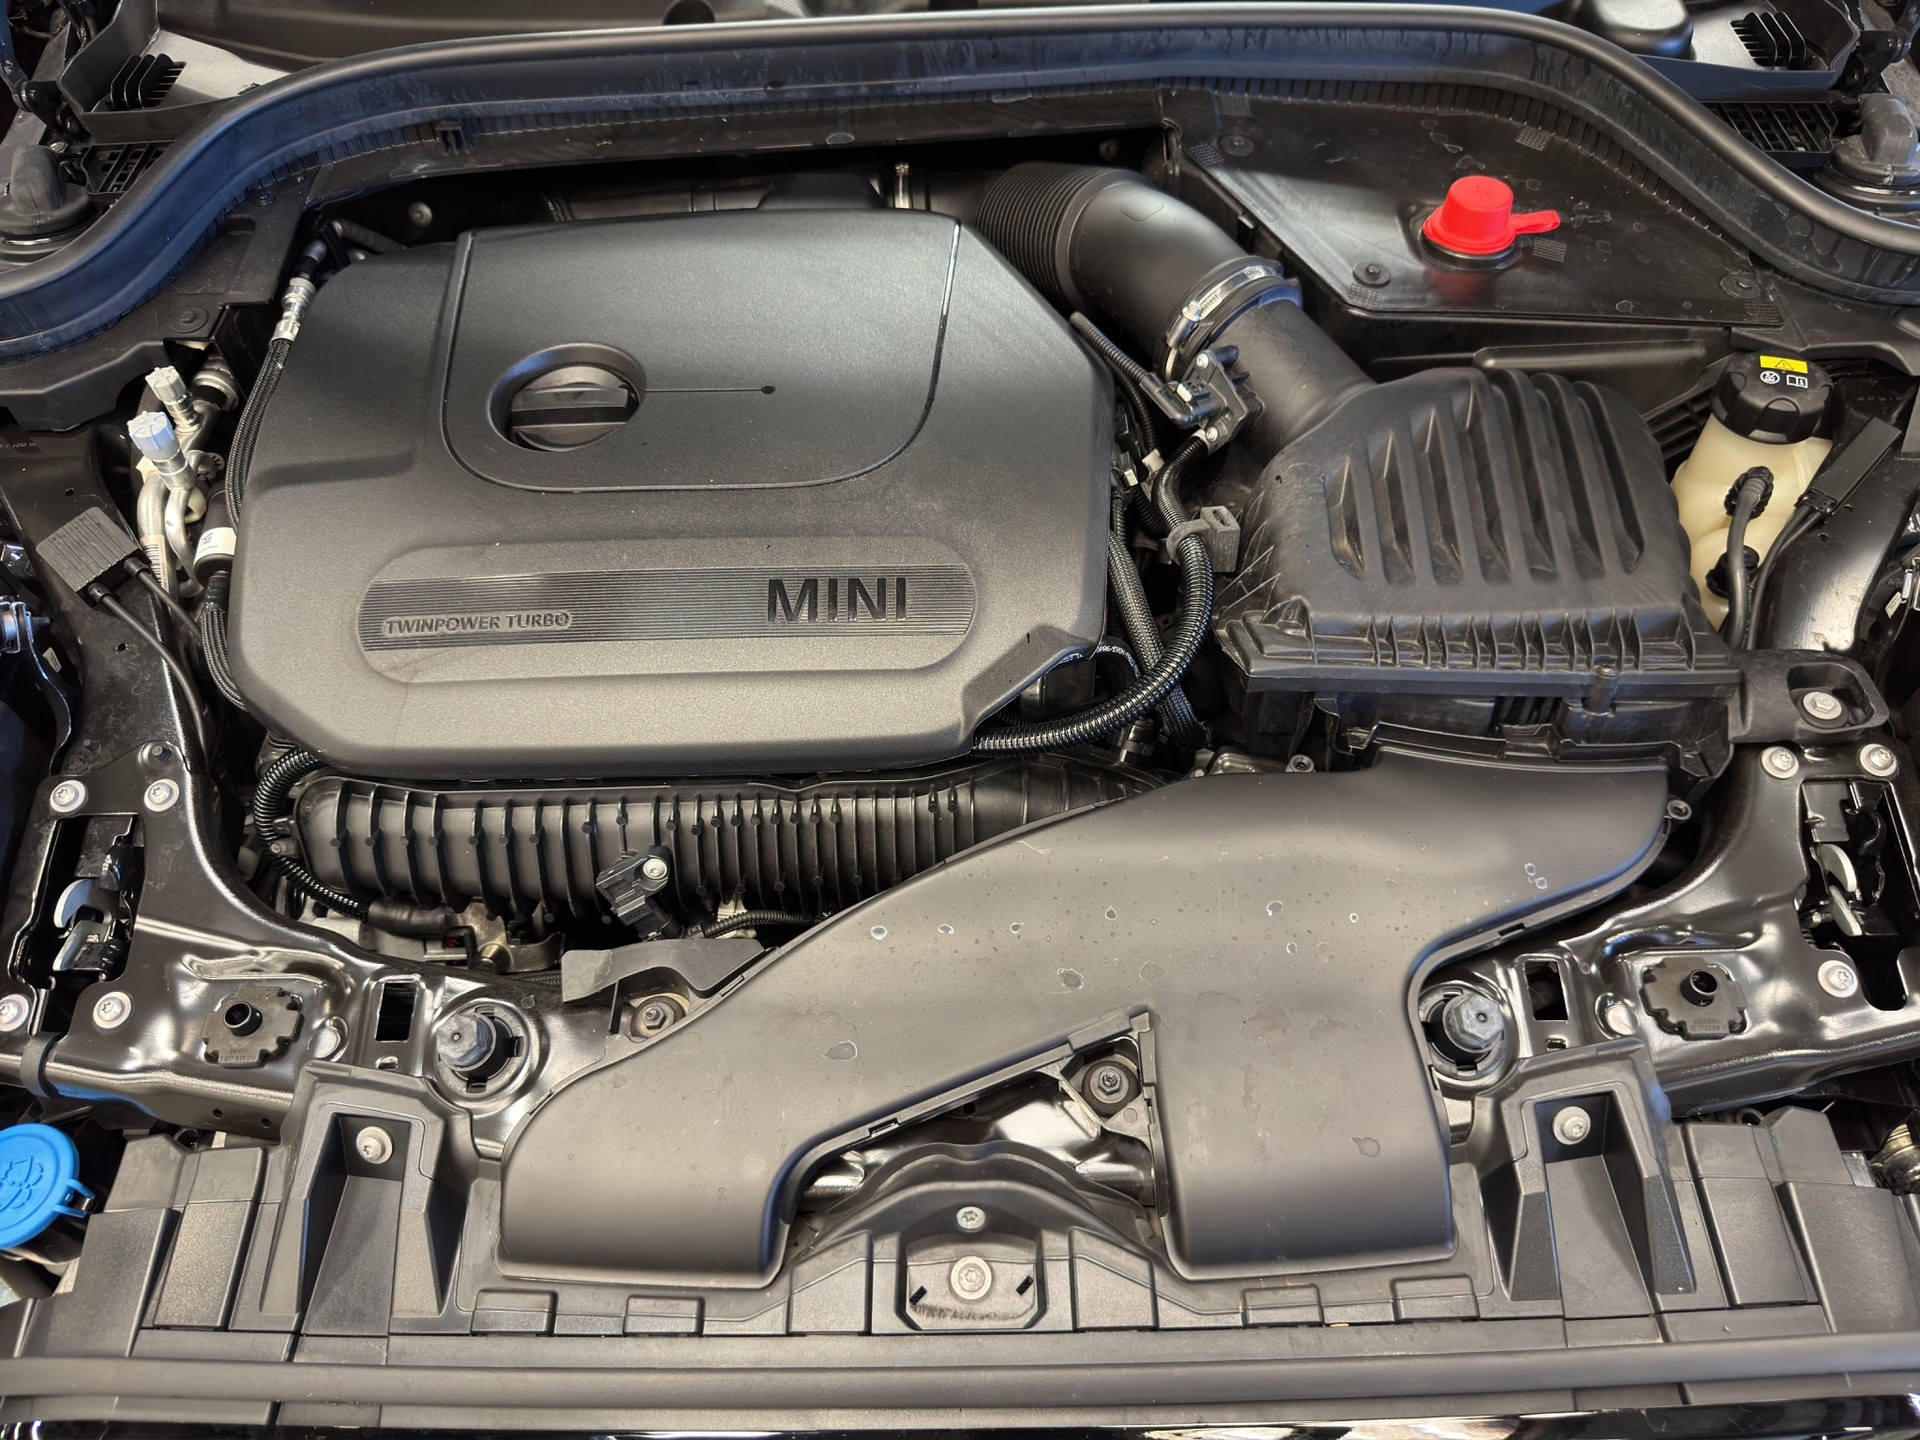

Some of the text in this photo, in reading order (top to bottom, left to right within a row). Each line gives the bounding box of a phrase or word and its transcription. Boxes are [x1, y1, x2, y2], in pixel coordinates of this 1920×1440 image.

[767, 577, 907, 623] MINI
[385, 611, 570, 635] TWINPOWER TURBO
